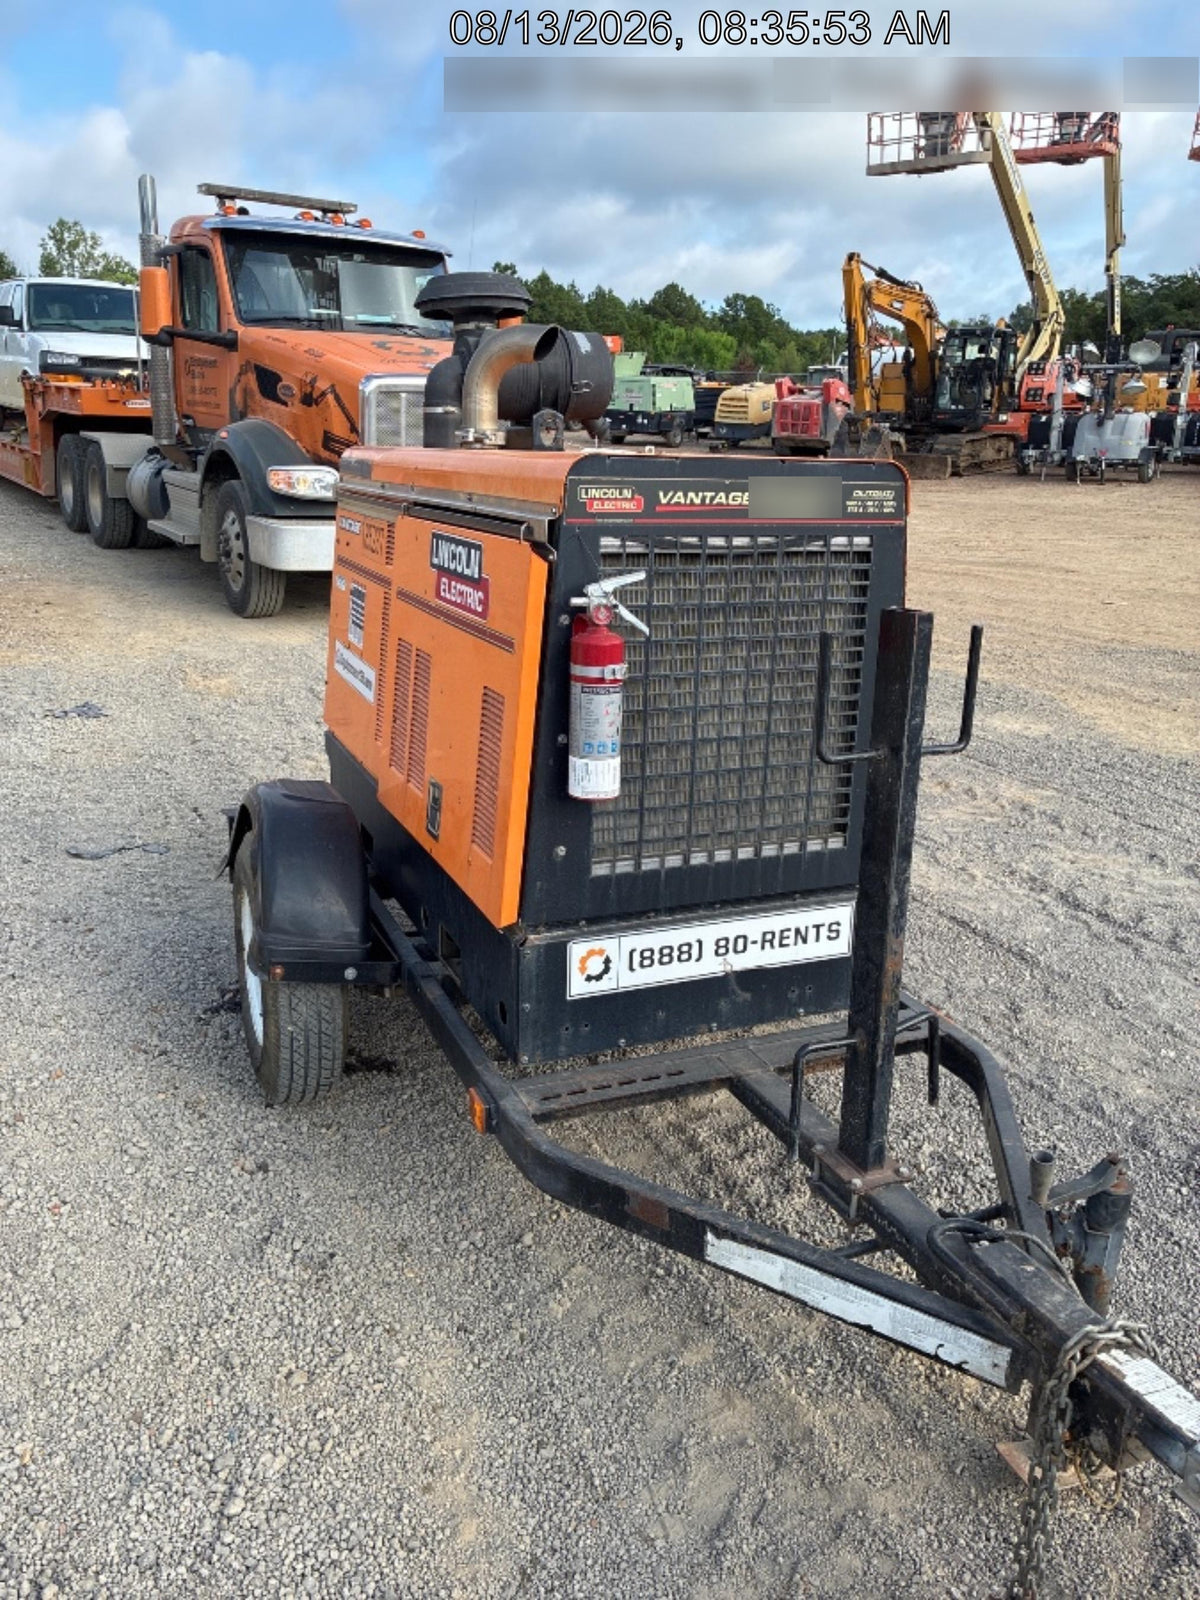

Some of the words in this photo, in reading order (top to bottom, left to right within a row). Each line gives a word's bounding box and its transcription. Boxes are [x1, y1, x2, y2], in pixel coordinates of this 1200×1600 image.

[580, 488, 632, 499] LINCOLN
[593, 500, 637, 509] ELECTRIC
[432, 538, 480, 578] LINCOLN
[440, 577, 484, 612] ELECTRIC
[628, 938, 703, 972] (888)
[713, 921, 842, 957] 80-RENTS
